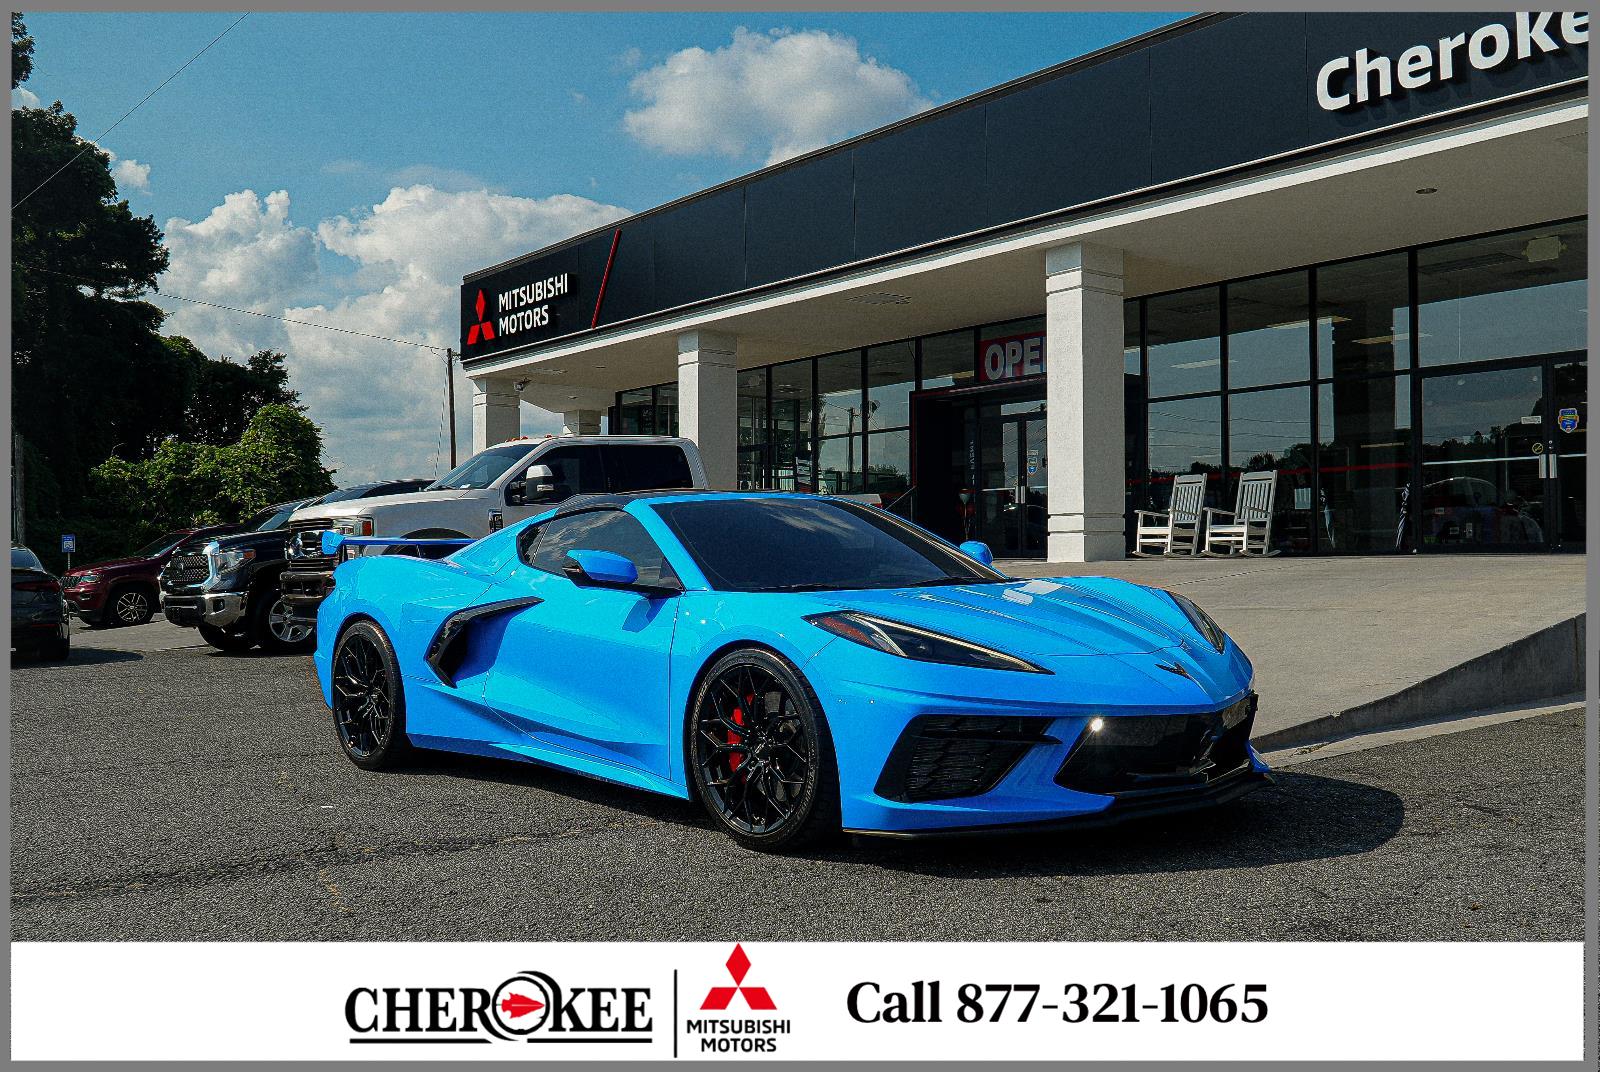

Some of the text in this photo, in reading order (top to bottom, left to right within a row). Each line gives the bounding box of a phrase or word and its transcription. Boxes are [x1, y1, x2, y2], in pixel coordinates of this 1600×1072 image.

[499, 273, 568, 312] MITSUBISHI
[499, 305, 549, 337] MOTORS
[985, 336, 1047, 380] OPE
